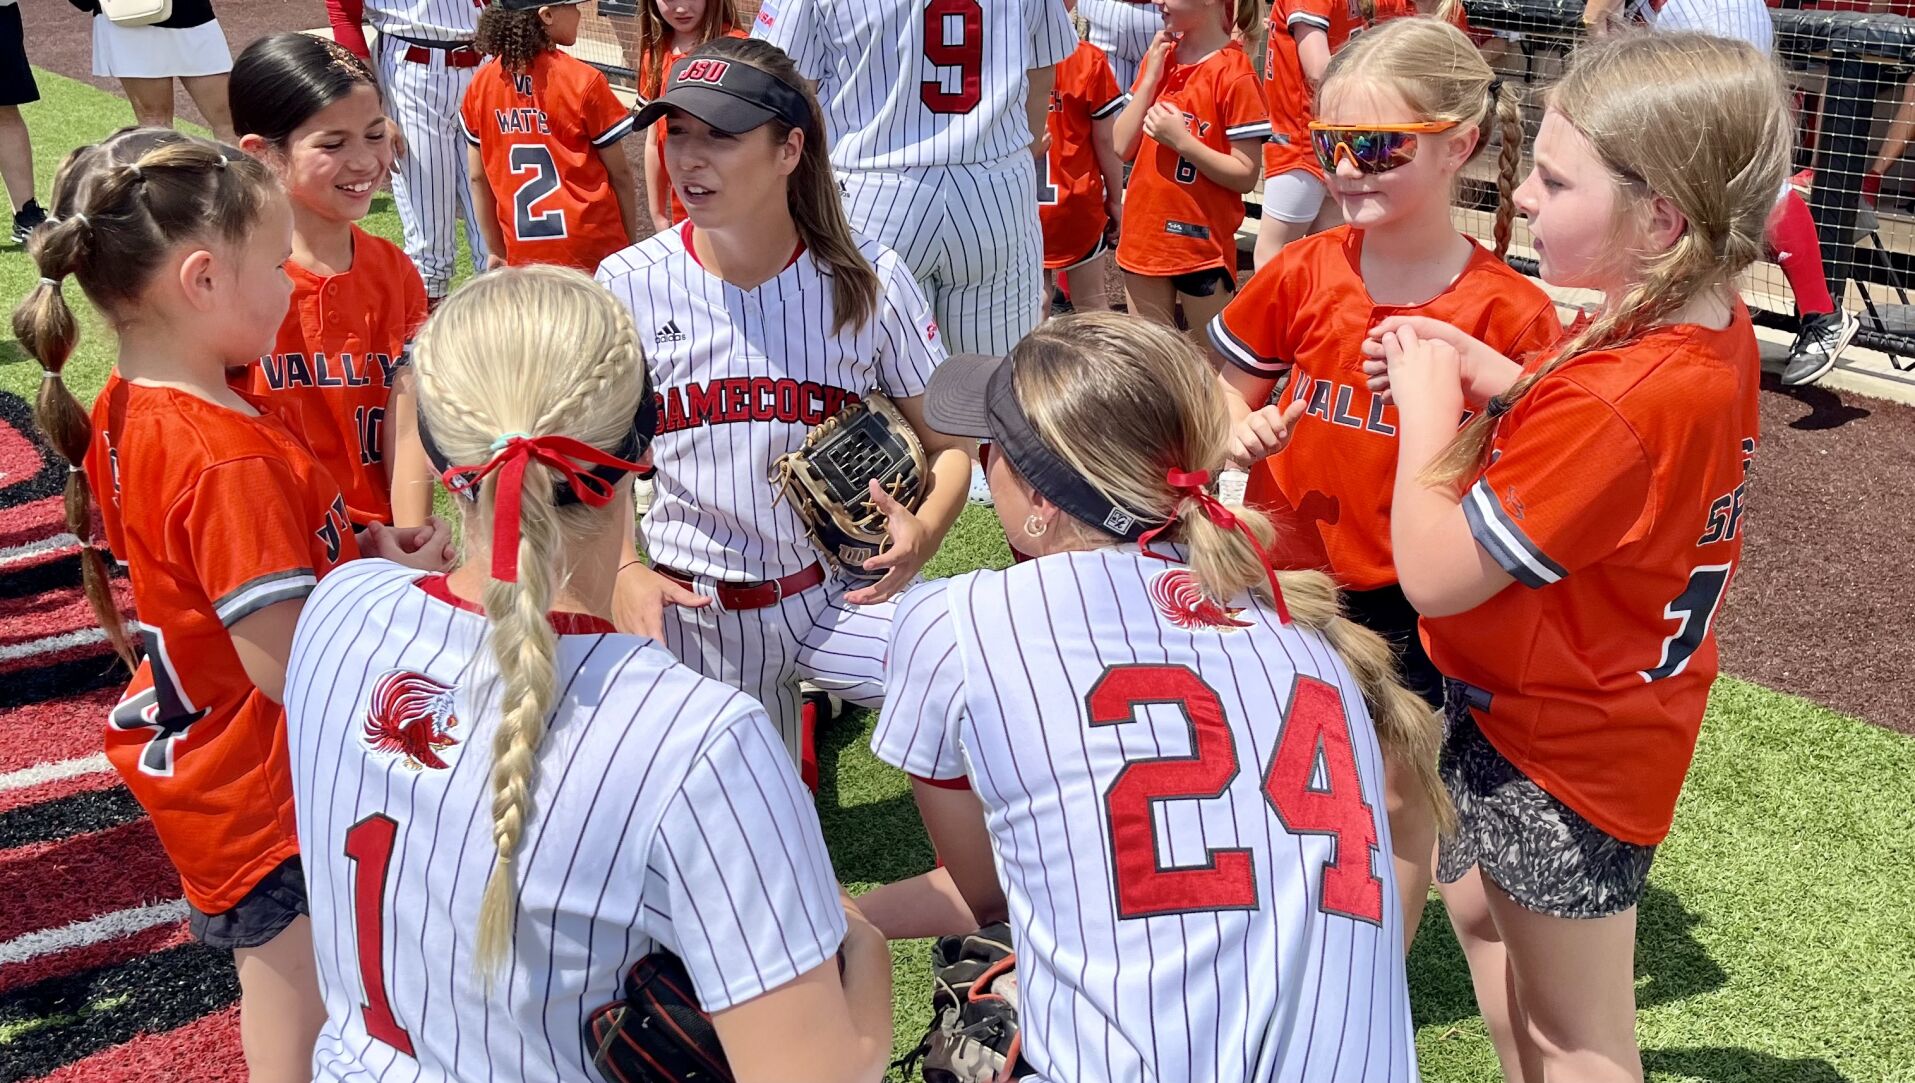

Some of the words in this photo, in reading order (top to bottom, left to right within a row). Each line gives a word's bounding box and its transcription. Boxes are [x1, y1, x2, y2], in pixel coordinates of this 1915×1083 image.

[677, 59, 730, 84] JSU
[920, 0, 983, 114] 9
[509, 144, 568, 241] 2
[655, 334, 687, 343] adidas
[108, 621, 212, 777] 4
[1084, 662, 1383, 928] 24
[344, 811, 418, 1060] 1
